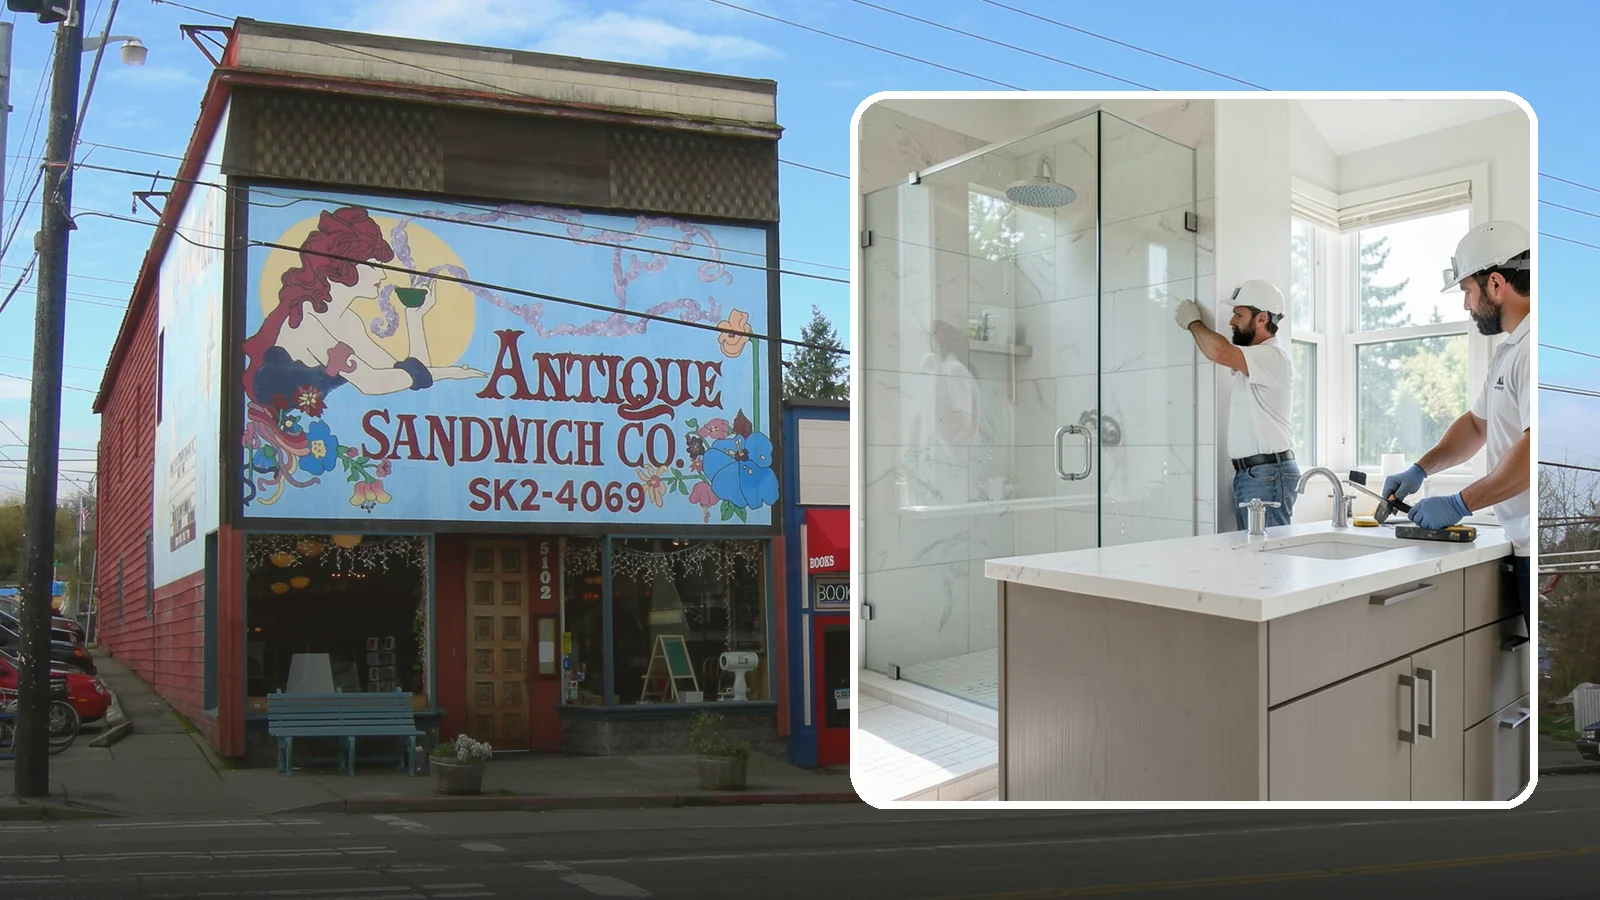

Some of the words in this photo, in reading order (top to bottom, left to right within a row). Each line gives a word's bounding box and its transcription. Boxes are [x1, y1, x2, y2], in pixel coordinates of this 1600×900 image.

[476, 328, 723, 421] ANTIQUE
[361, 408, 604, 467] SANDWICH
[617, 422, 685, 468] CO.
[468, 477, 646, 513] SK2-4069
[540, 542, 552, 600] 5102
[809, 555, 835, 569] BOOKS
